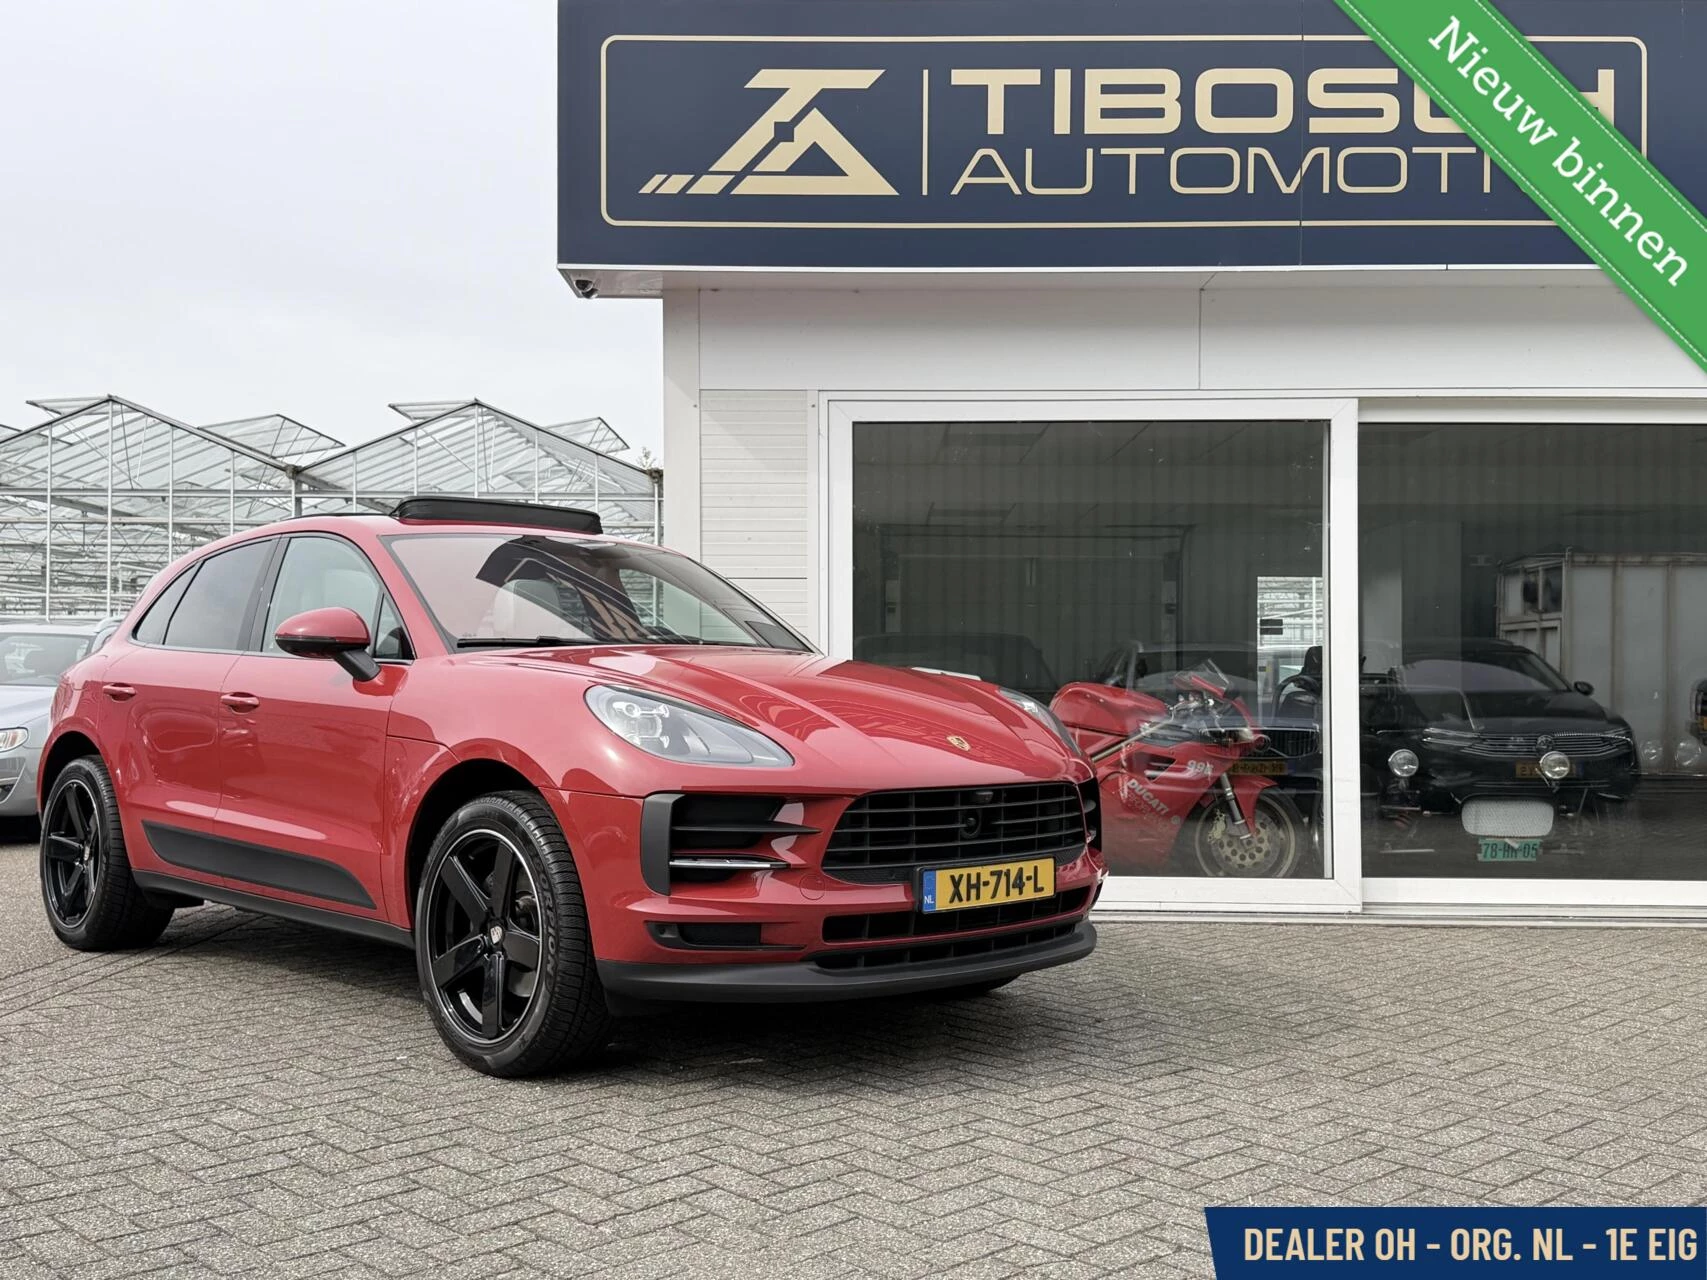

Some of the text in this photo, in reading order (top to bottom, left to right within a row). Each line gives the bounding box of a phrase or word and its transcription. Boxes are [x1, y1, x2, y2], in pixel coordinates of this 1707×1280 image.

[1127, 778, 1168, 815] DUCATI
[924, 895, 935, 904] NL
[948, 865, 1045, 904] XH-714-L
